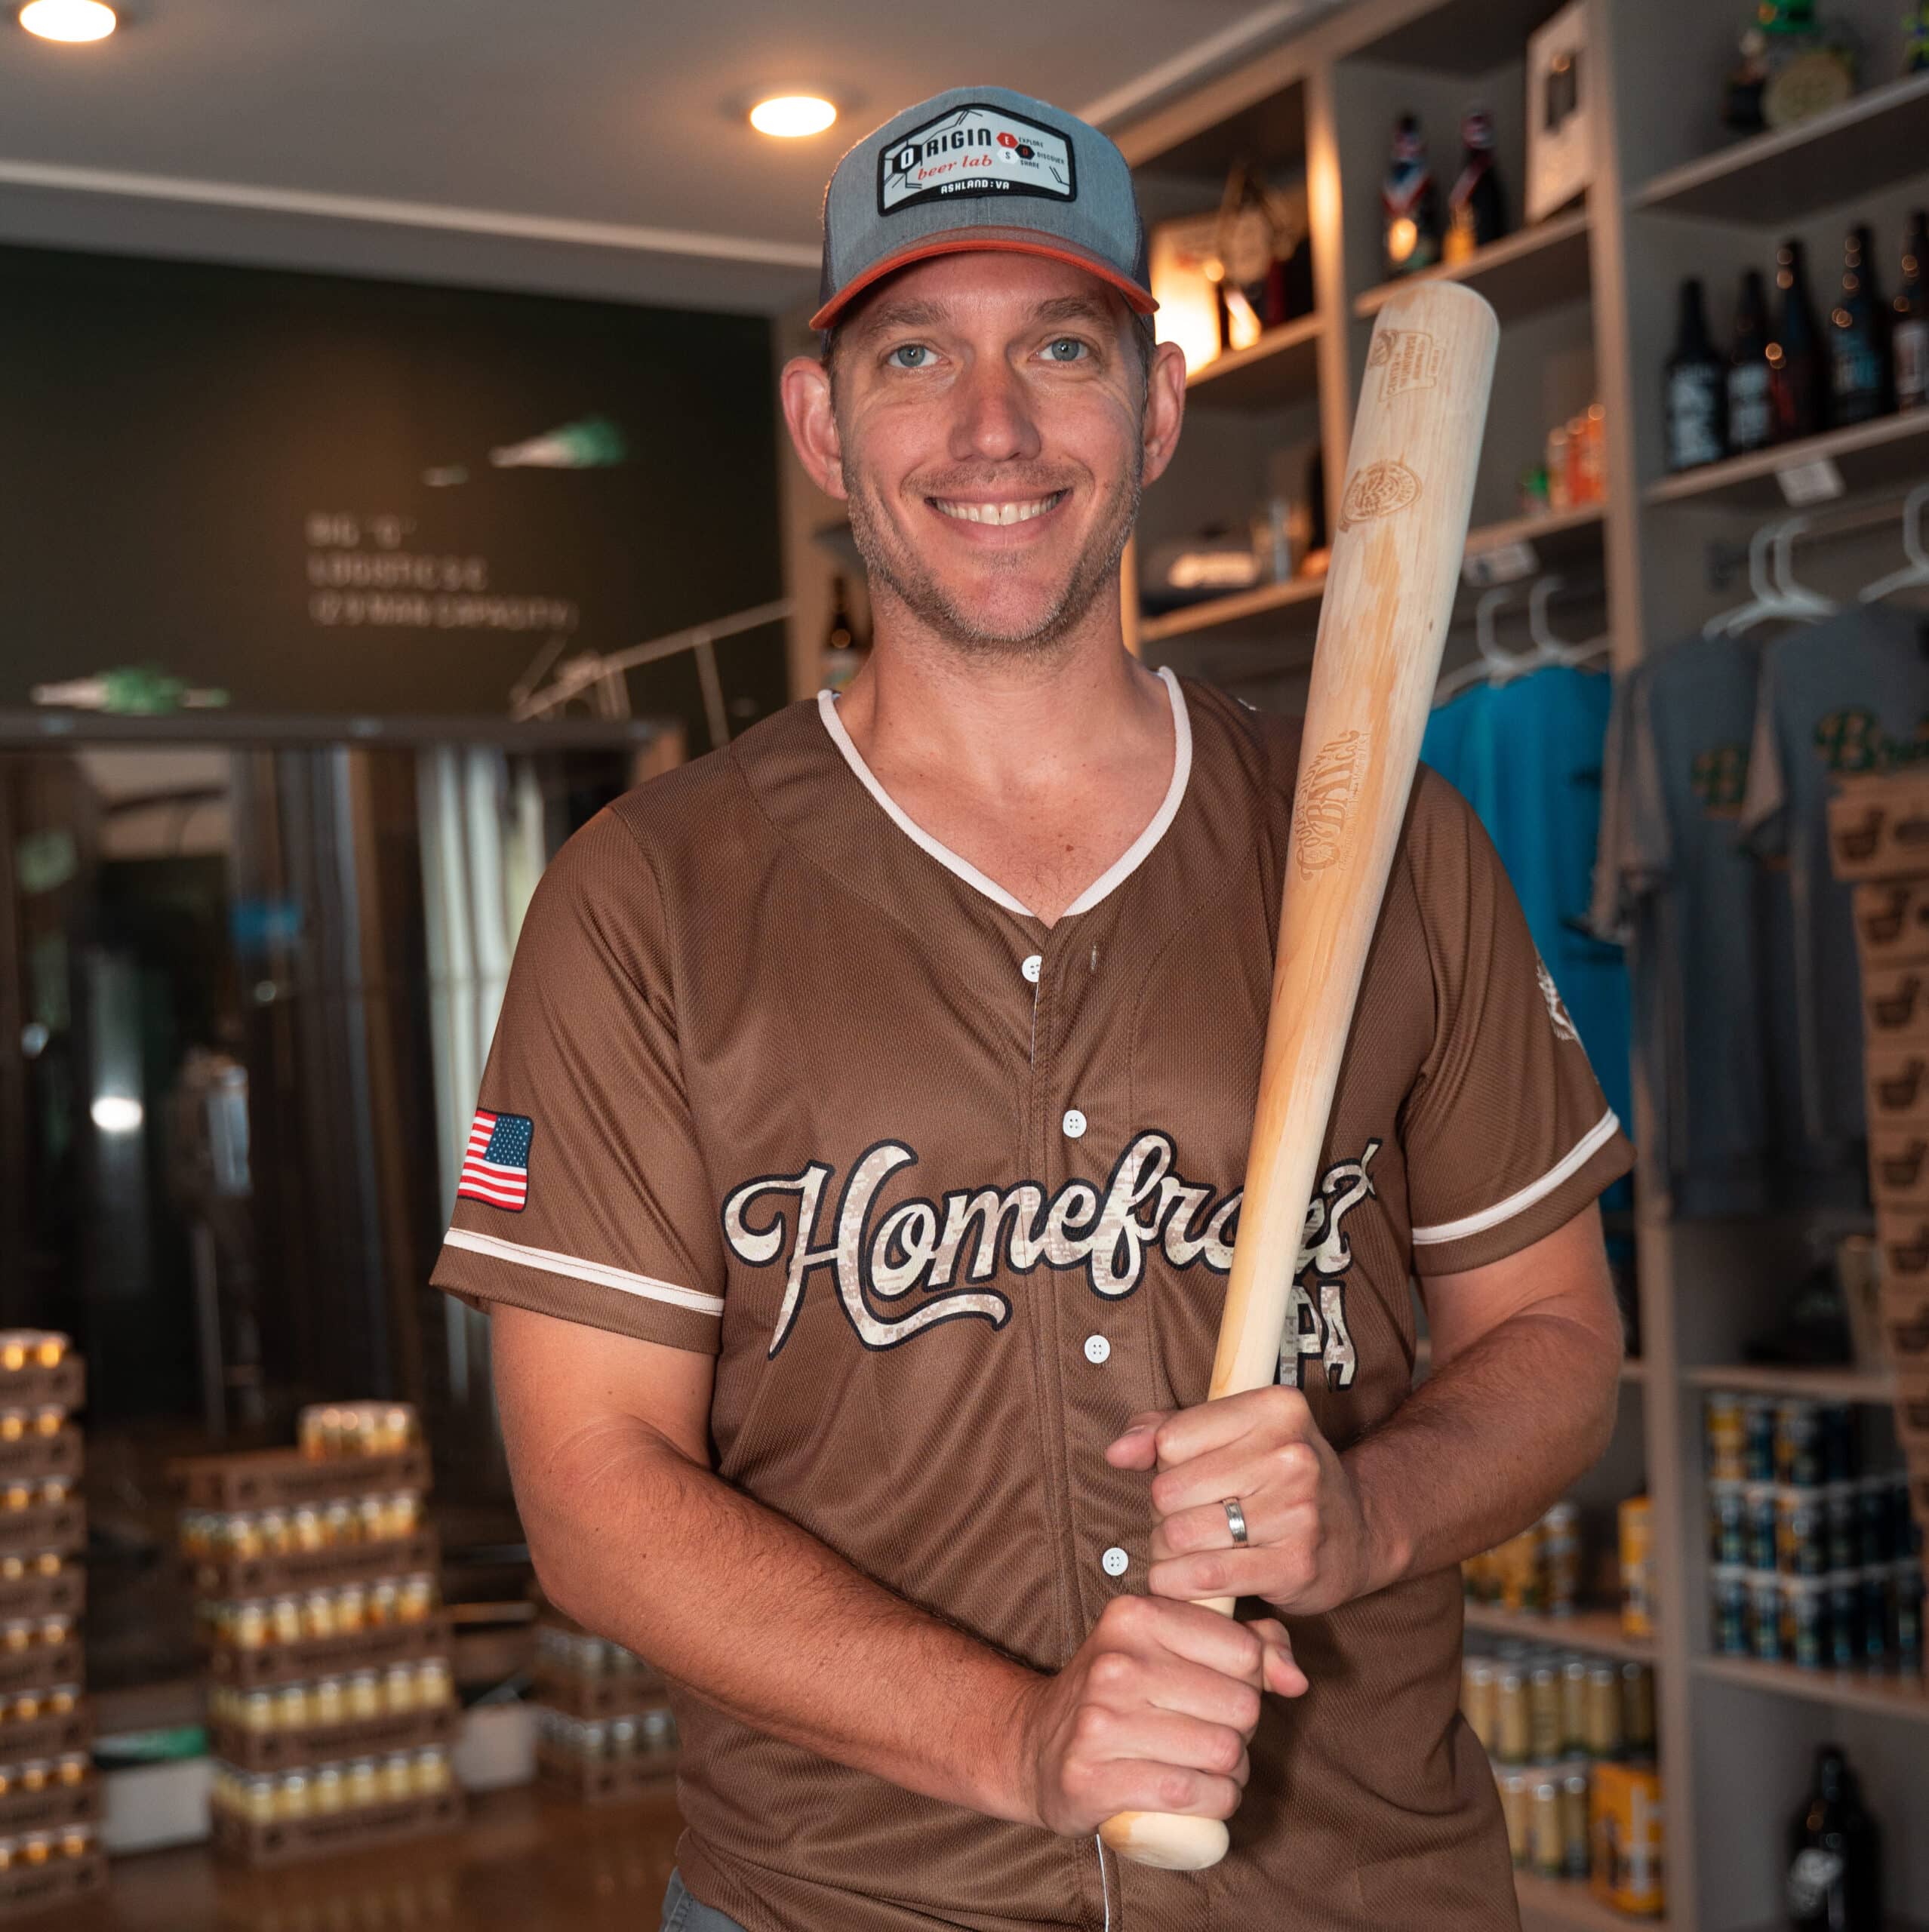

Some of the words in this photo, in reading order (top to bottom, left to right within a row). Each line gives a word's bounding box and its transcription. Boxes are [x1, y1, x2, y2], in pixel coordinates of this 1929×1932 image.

[900, 128, 992, 170] ORIGIN
[1019, 137, 1043, 148] EXPLORE
[918, 159, 957, 180] beer
[962, 155, 992, 168] lab
[1020, 159, 1040, 169] SHARE
[1037, 151, 1065, 165] DISCOVER
[1306, 757, 1355, 838] BAT
